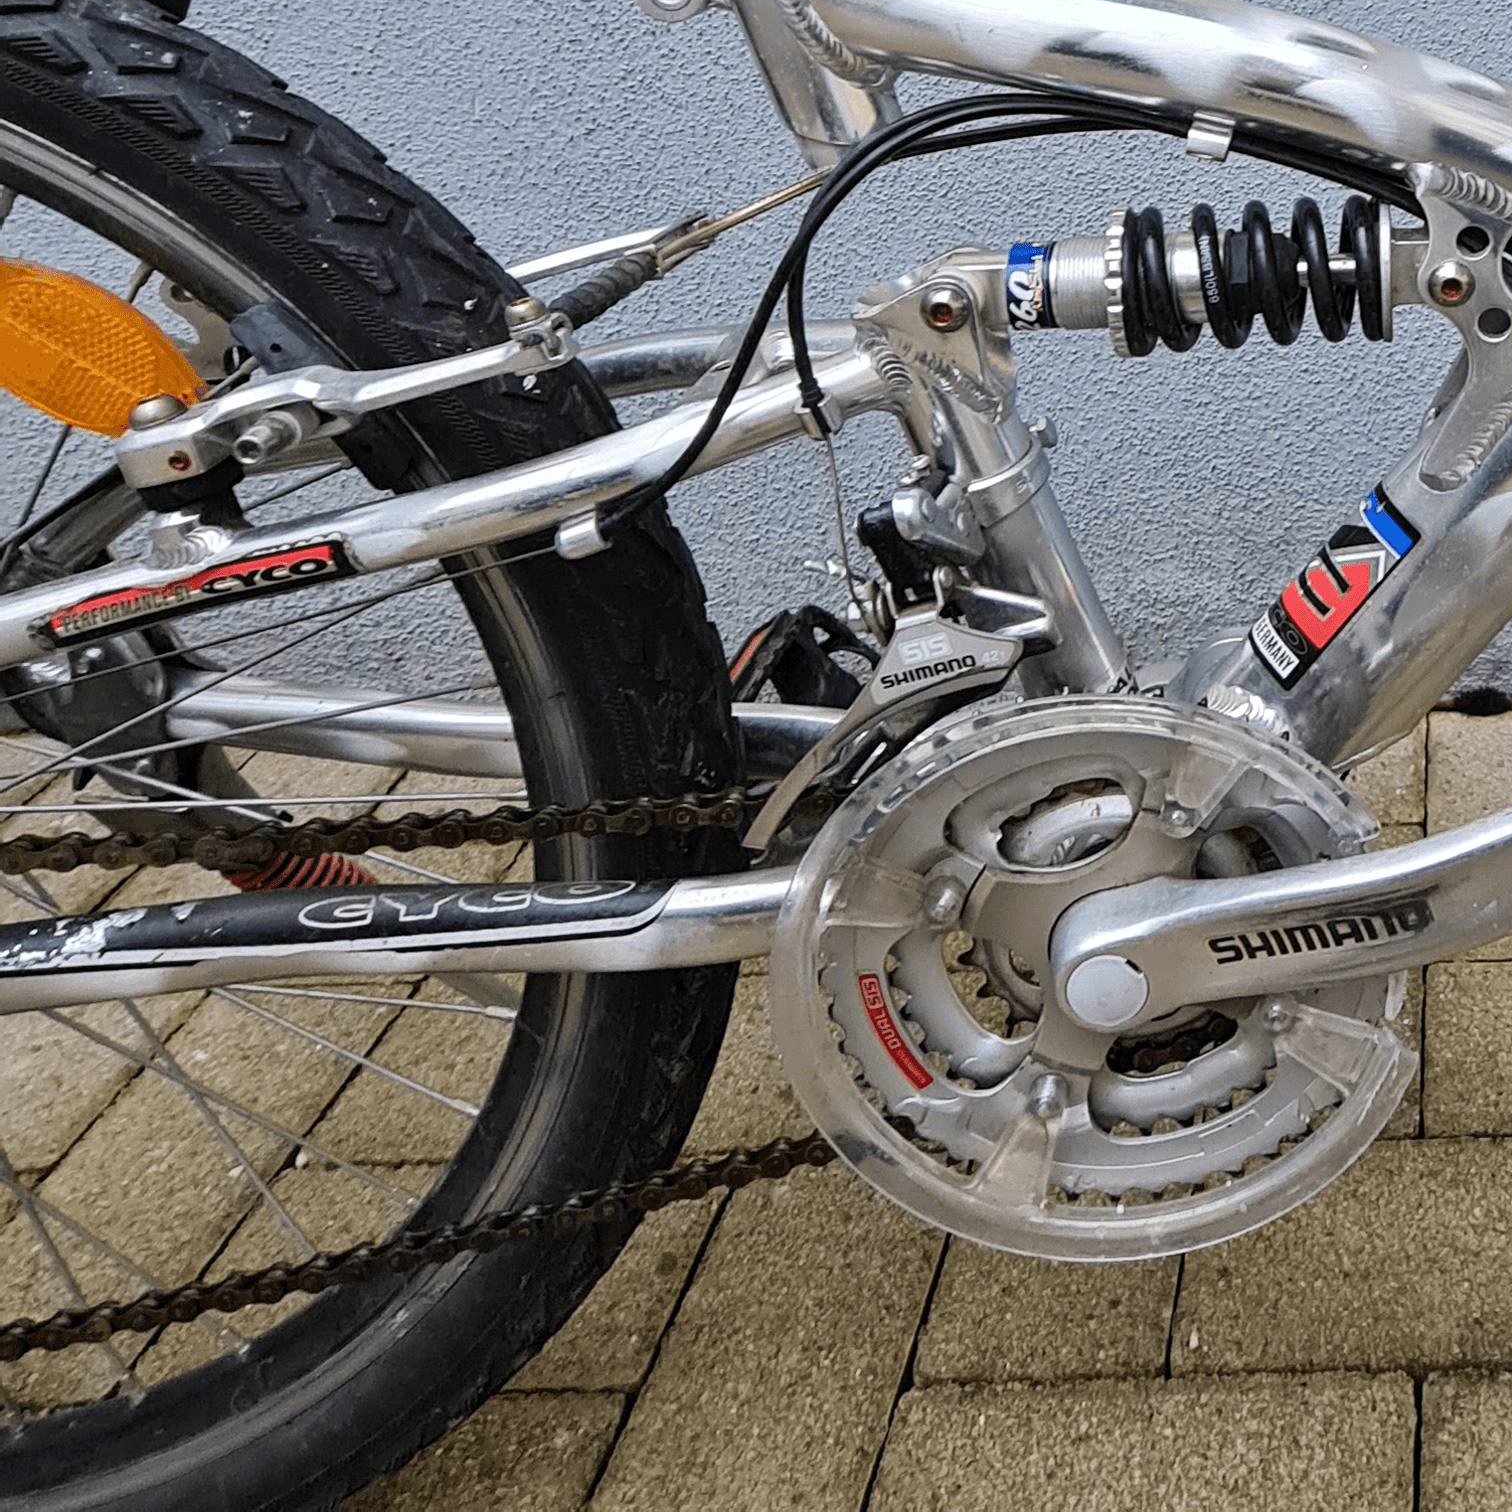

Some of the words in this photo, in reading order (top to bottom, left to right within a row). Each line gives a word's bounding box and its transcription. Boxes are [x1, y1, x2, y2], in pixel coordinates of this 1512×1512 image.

[200, 557, 331, 596] CYCO
[900, 632, 952, 666] SIS
[1253, 617, 1296, 672] GERMANY
[880, 654, 977, 690] SHIMANO
[299, 879, 637, 930] CYCO
[1208, 899, 1435, 965] SHIMANO
